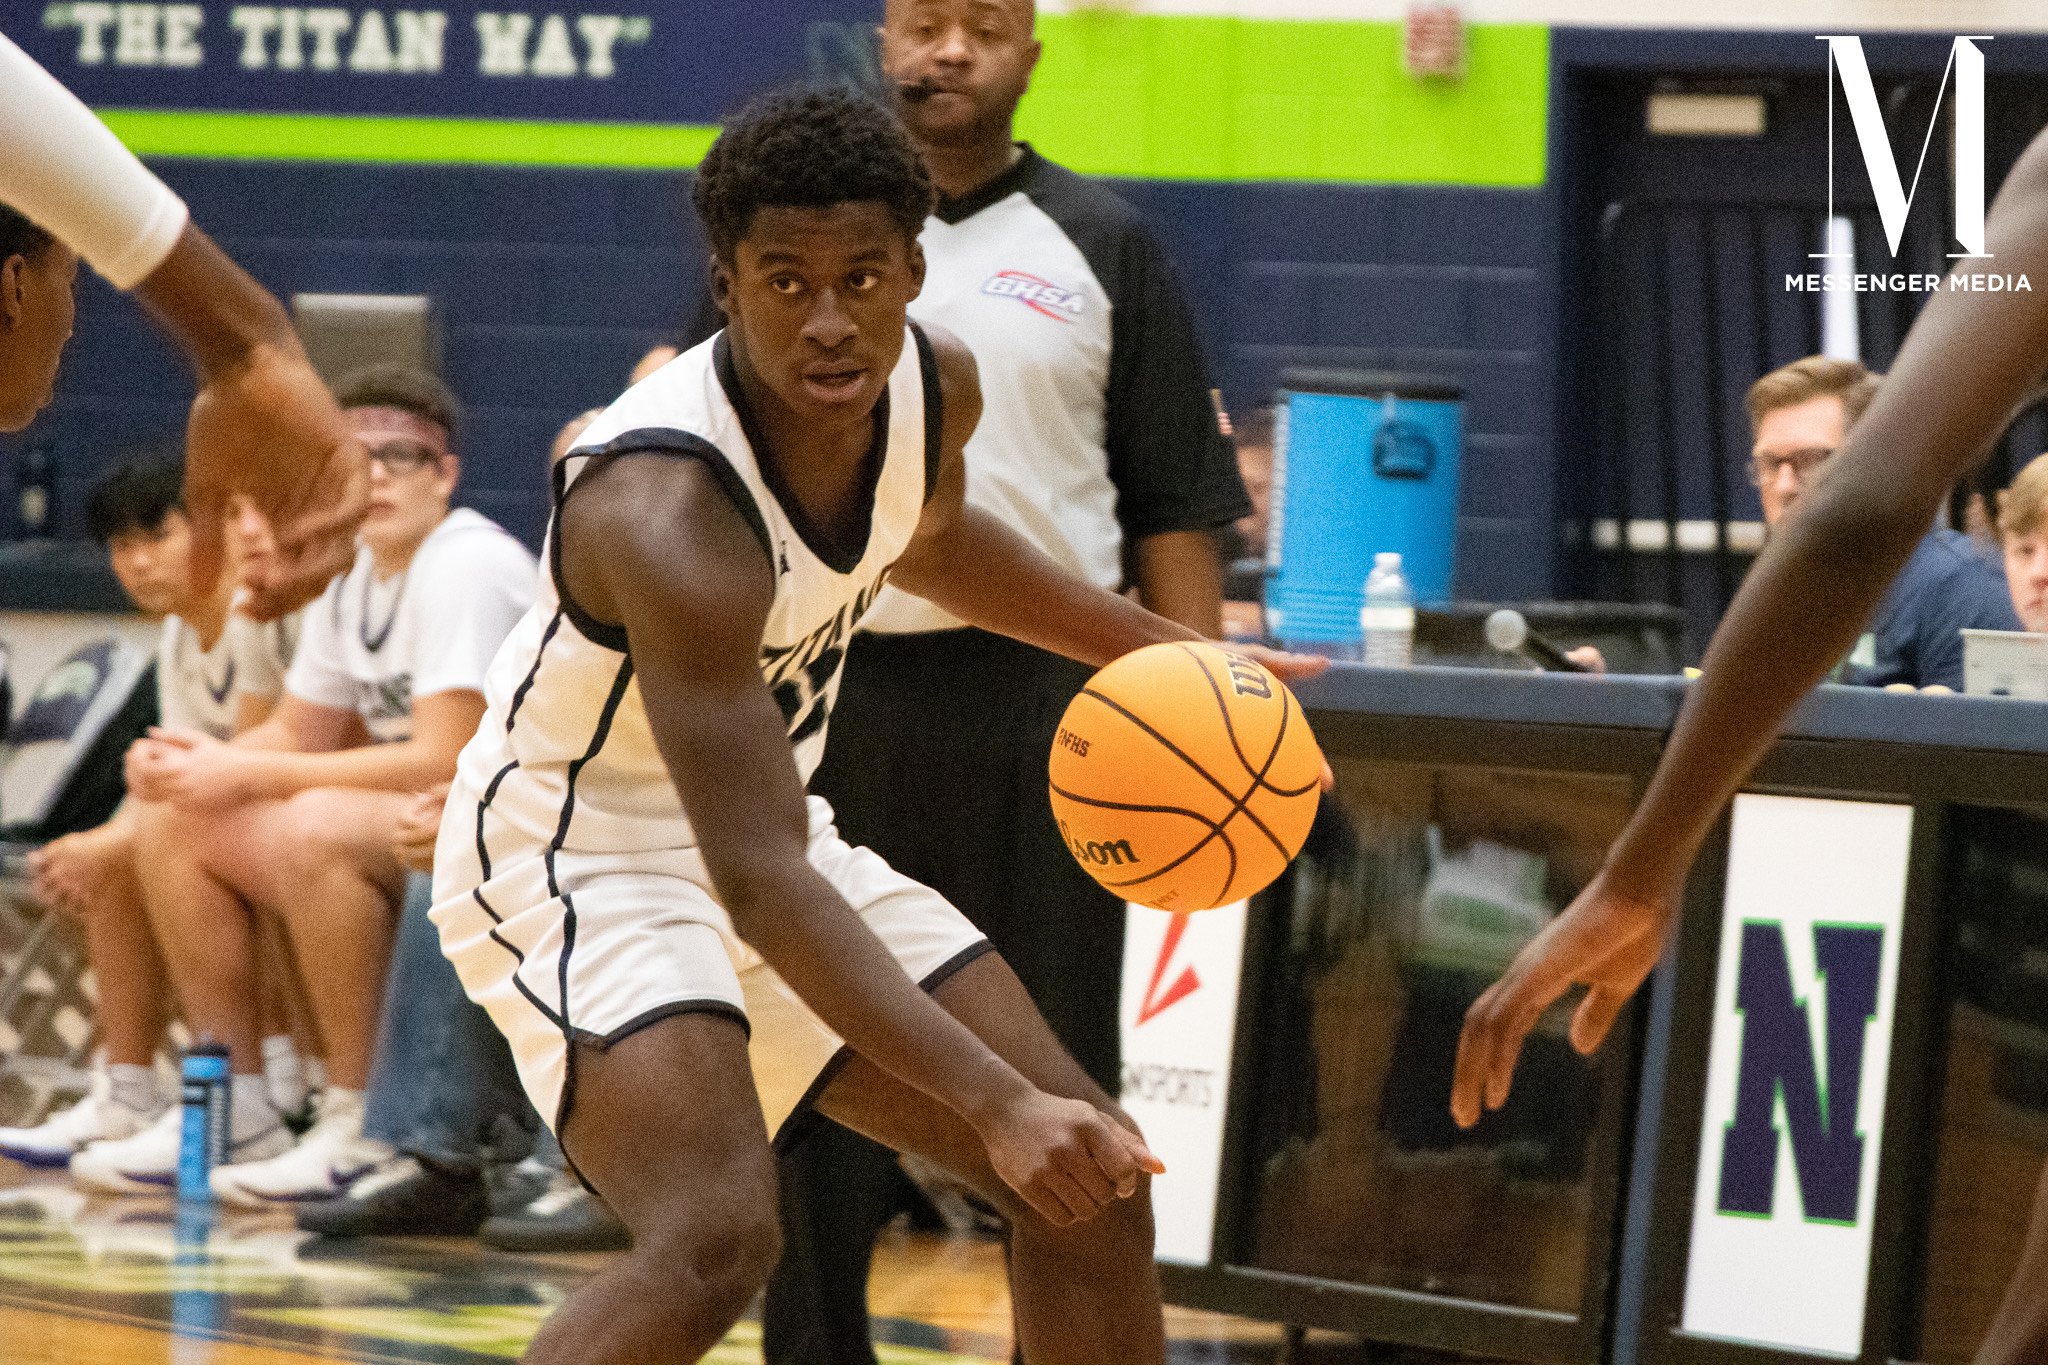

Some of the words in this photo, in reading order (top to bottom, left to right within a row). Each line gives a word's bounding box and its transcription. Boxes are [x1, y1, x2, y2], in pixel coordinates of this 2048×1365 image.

[231, 7, 447, 73] TITAN
[980, 276, 1085, 315] GHSA
[1716, 916, 1886, 1228] N
